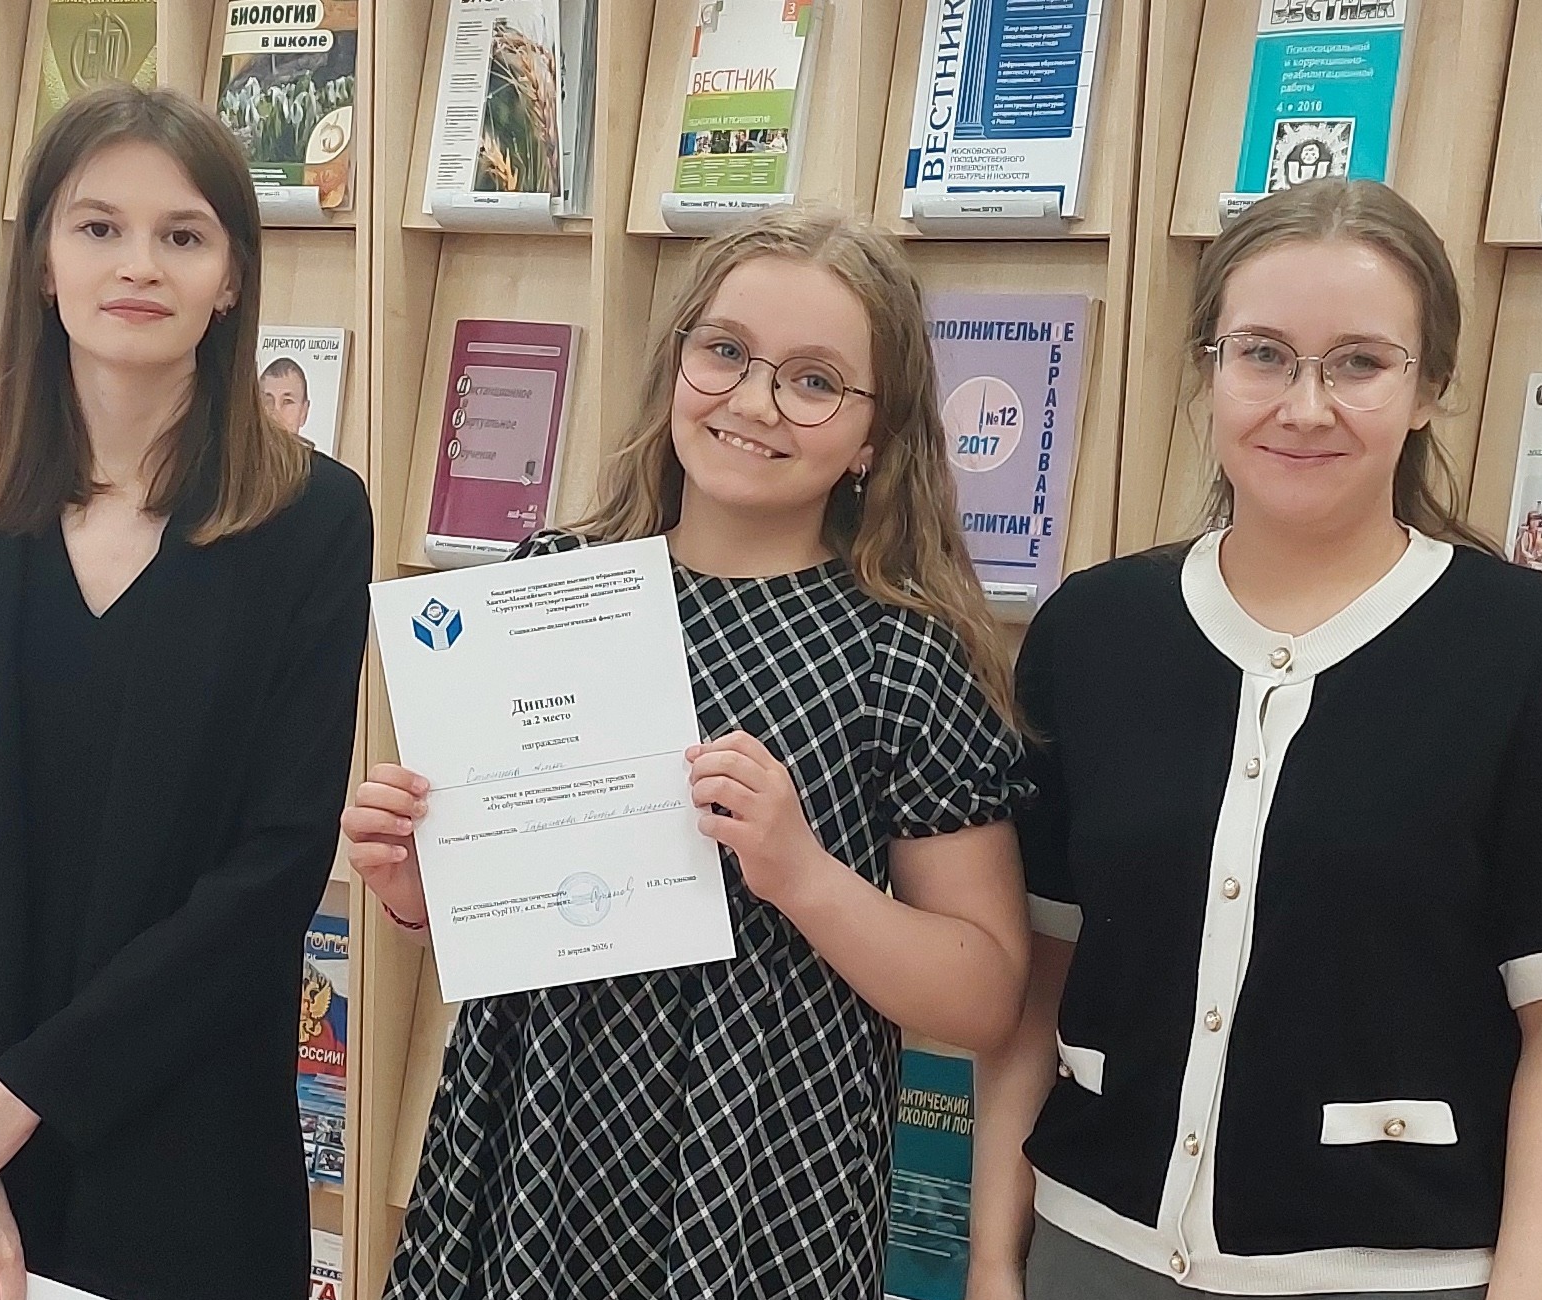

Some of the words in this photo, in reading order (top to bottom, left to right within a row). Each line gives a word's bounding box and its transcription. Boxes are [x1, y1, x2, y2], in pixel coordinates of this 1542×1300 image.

[231, 5, 317, 26] БИОЛОГИЯ
[787, 2, 795, 15] 3
[261, 36, 269, 47] в
[274, 35, 327, 47] школе
[693, 68, 778, 94] ВЕСТНИК
[921, 0, 965, 182] ВЕСТНИК
[1280, 83, 1314, 94] работы
[926, 320, 1074, 342] ОПОЛНИТЕЛЬНОЕ
[958, 435, 1000, 455] 2017
[963, 512, 1053, 536] СПИТАНИЕ
[512, 693, 576, 716] Диплом
[522, 718, 531, 727] за
[534, 715, 540, 724] 2
[543, 712, 571, 723] место
[522, 734, 579, 751] награждается
[299, 1046, 344, 1065] ОССИИ!
[900, 1088, 969, 1116] АКТИЧЕСКИЙ
[942, 1115, 951, 1130] И
